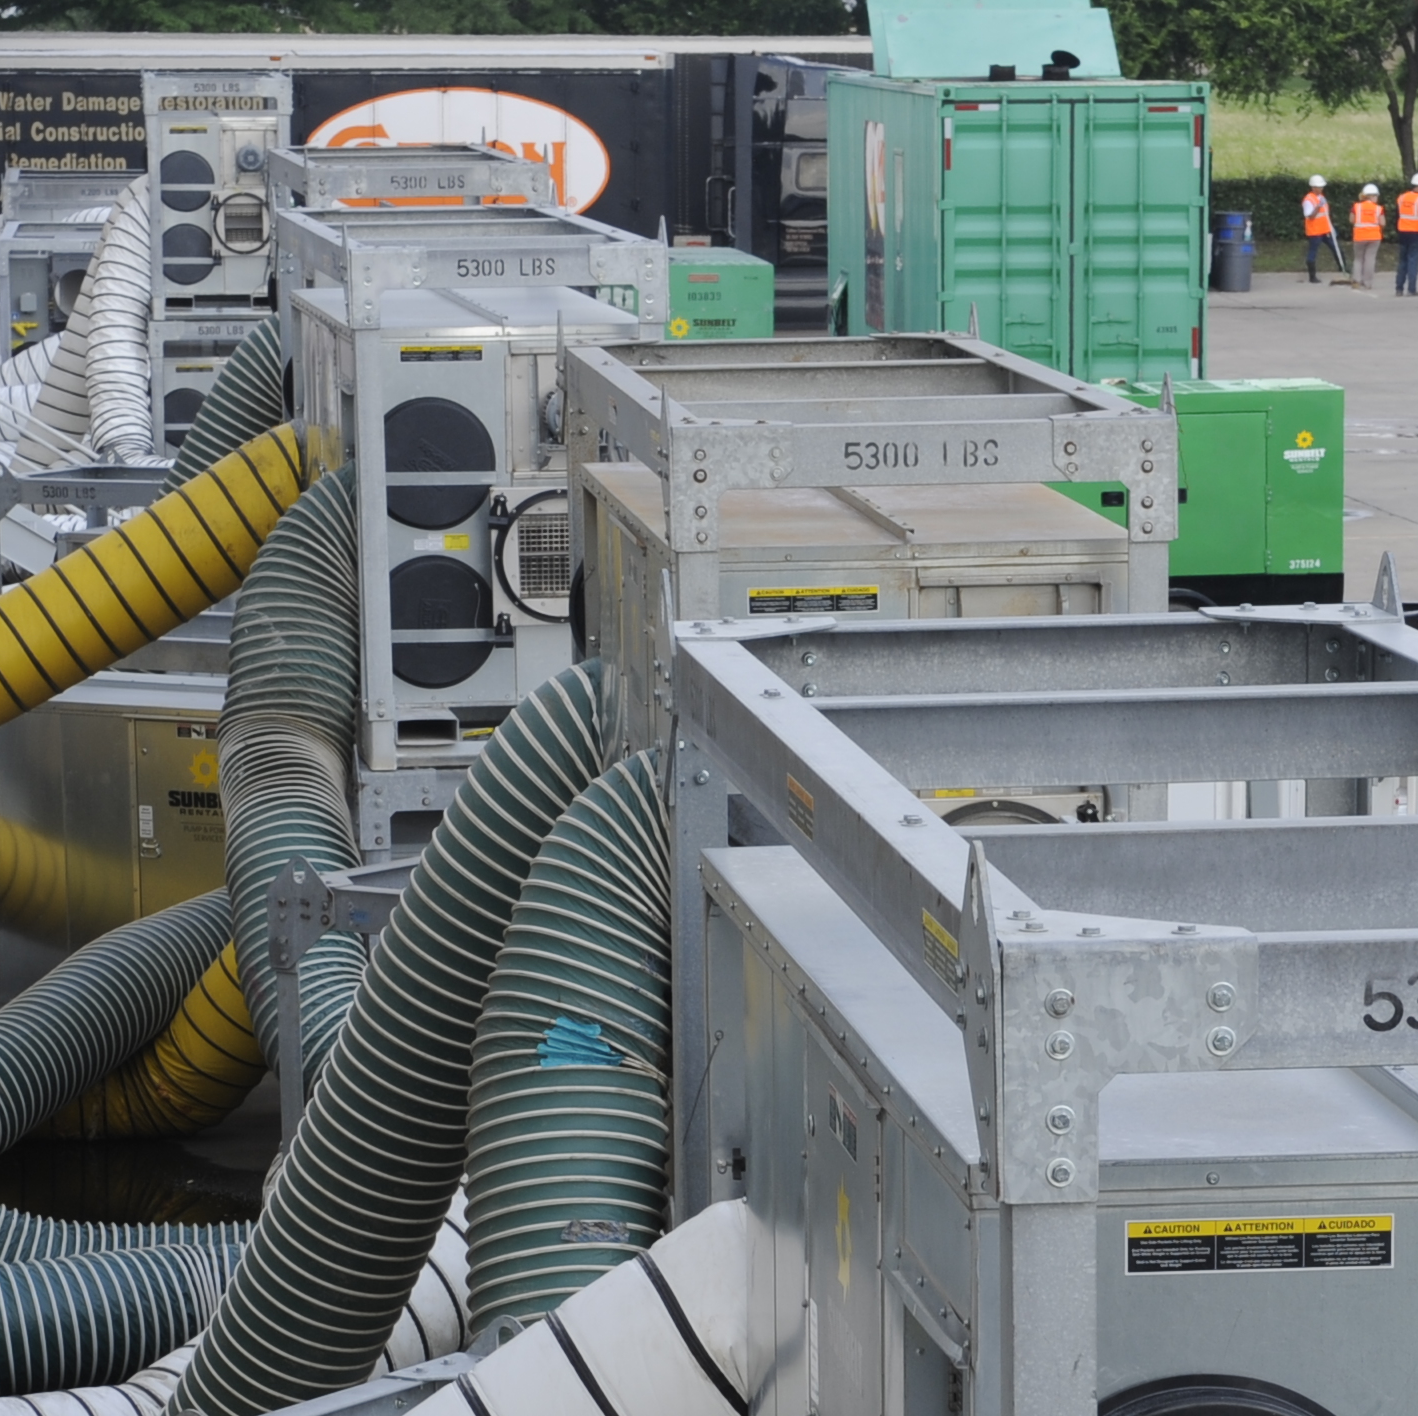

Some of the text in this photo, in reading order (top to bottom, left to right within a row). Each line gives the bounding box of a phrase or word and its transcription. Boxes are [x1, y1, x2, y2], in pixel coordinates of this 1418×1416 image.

[194, 83, 241, 93] 5300 LBS
[62, 91, 141, 115] Damage
[158, 96, 264, 111] estoration
[390, 174, 465, 190] 5300 LBS
[457, 257, 555, 278] 5300 LBS
[226, 325, 245, 335] LBS
[693, 319, 737, 328] SUNBELT
[844, 441, 919, 471] 5300
[1283, 448, 1326, 460] SUNBELT
[42, 485, 97, 500] 5300 LBS
[1153, 1219, 1376, 1235] CAUTION ATTENTION CUIDADO
